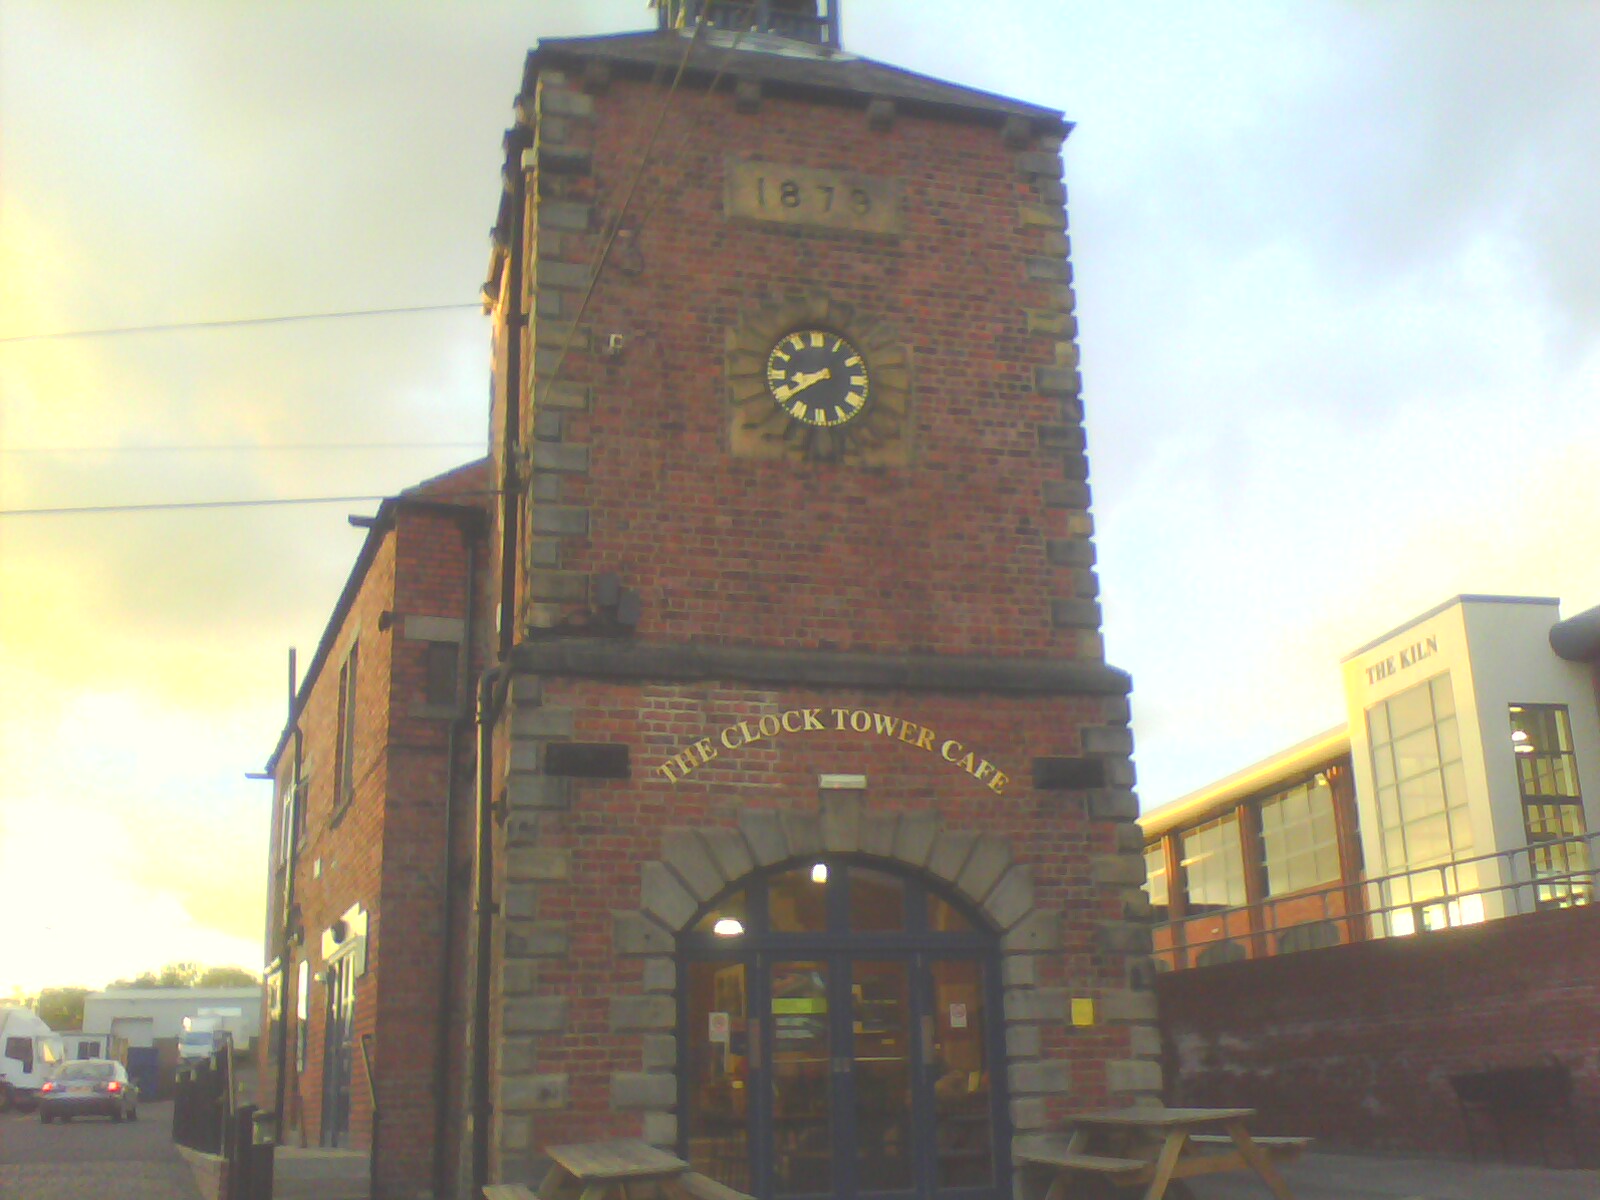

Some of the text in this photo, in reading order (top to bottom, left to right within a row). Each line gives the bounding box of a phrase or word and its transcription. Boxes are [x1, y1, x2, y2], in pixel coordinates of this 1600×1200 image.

[1365, 634, 1438, 685] THE KILN
[657, 708, 1010, 794] THE CLOCK TOWER CAFE
